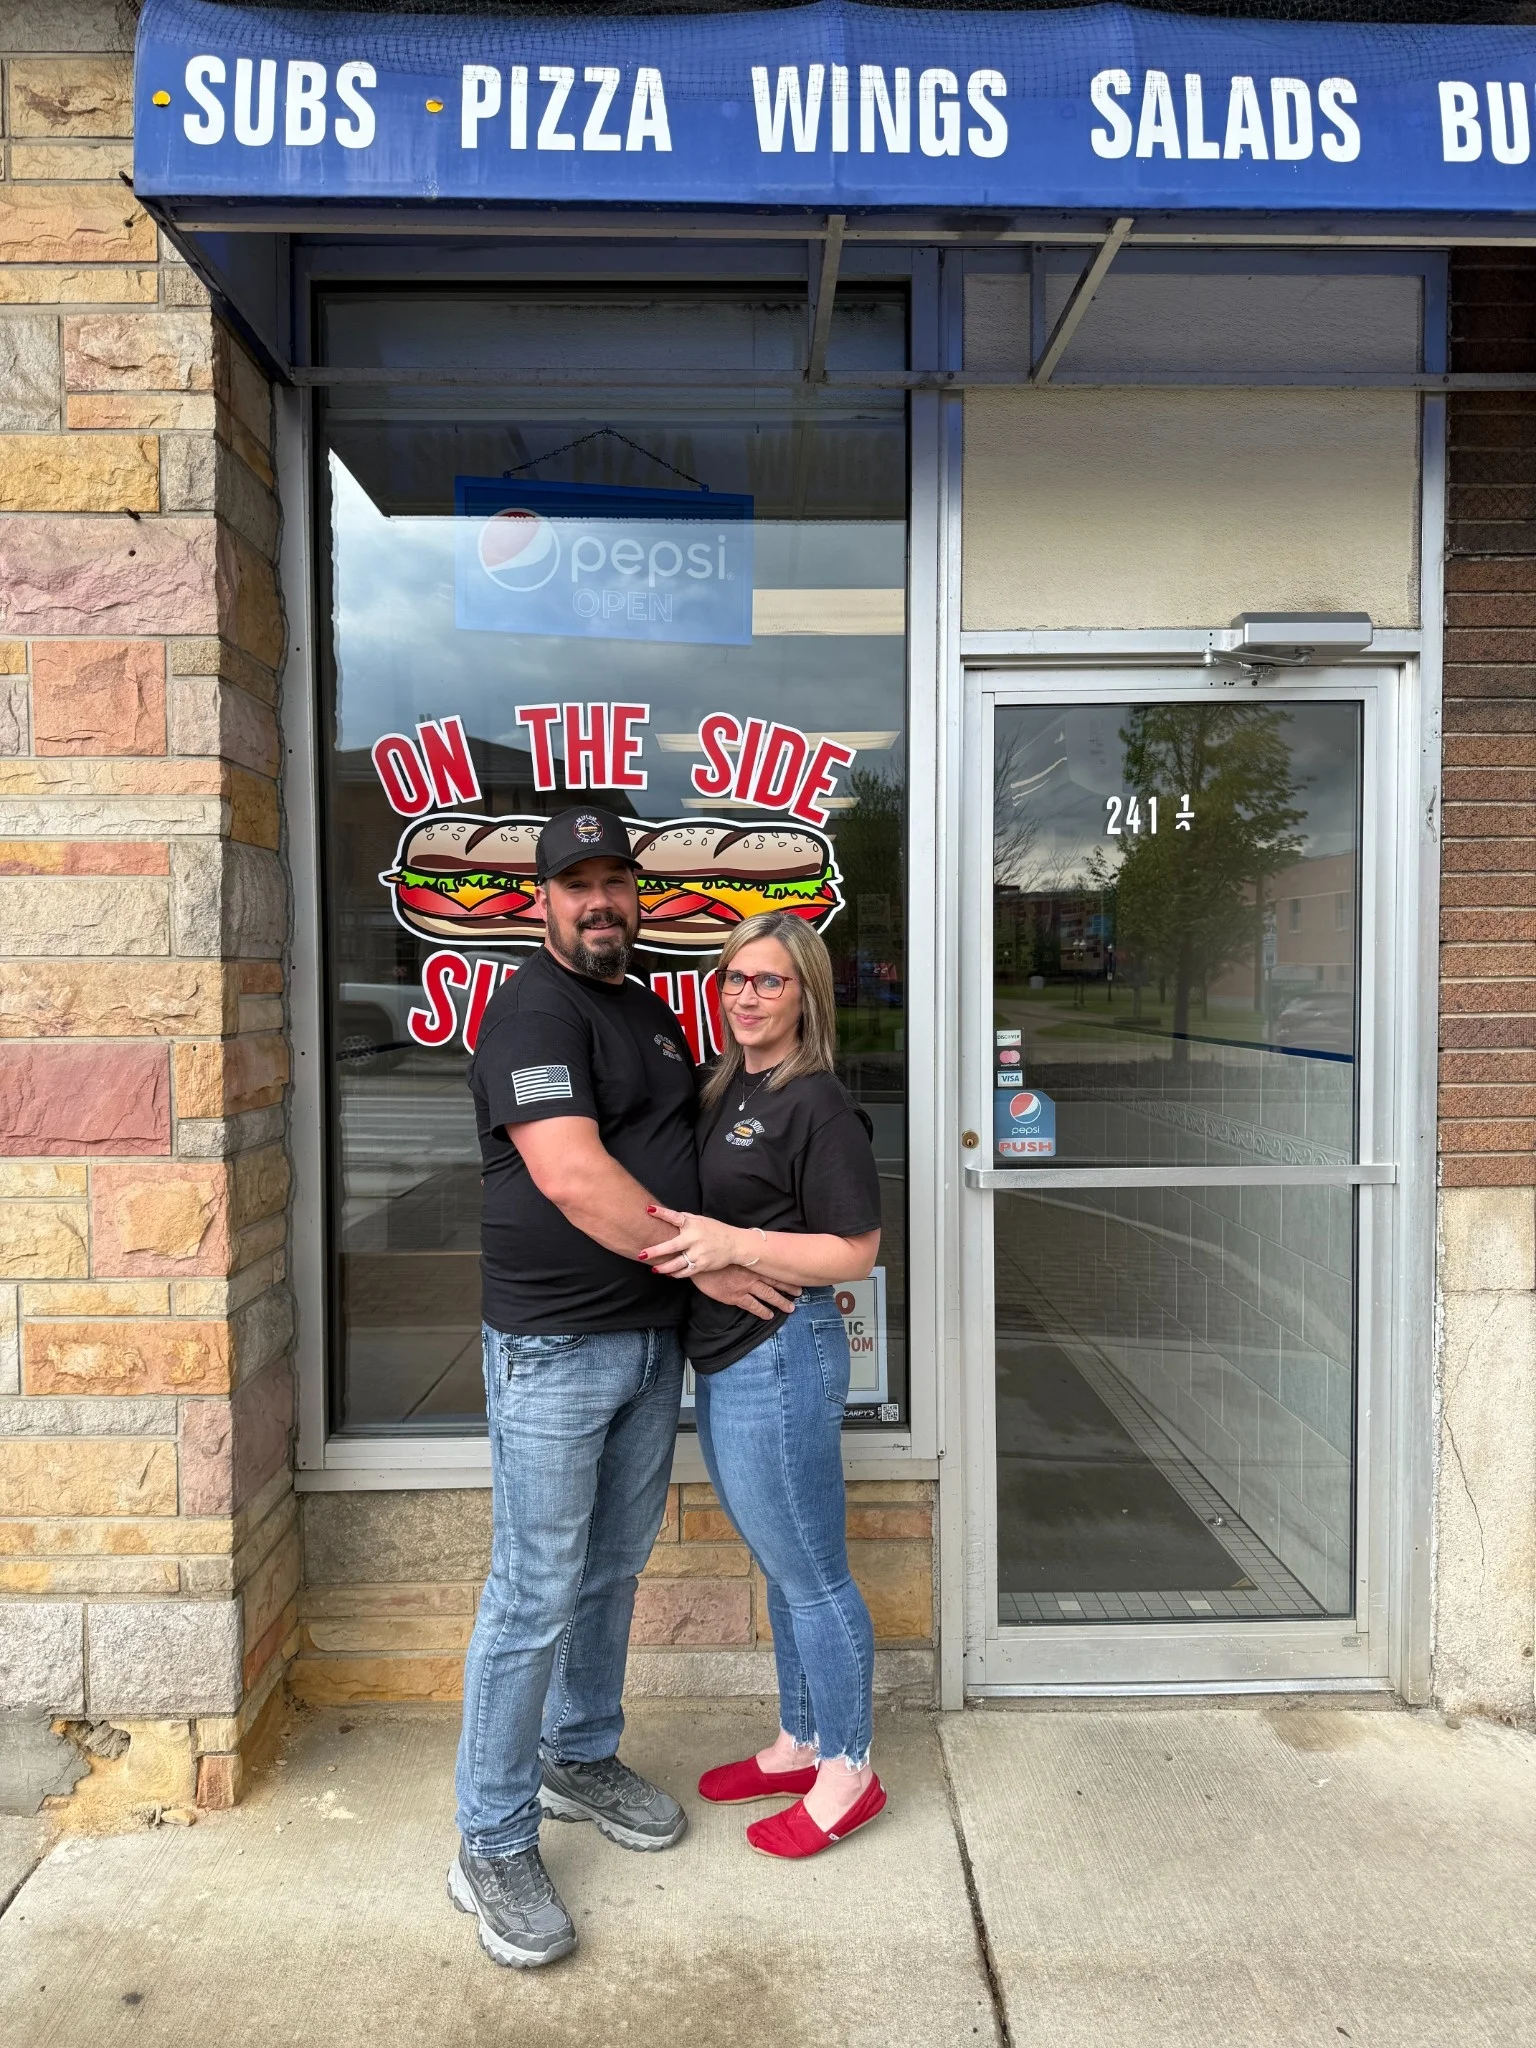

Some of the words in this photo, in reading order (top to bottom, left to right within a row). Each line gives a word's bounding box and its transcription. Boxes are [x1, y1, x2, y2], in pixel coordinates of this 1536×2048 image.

[184, 55, 377, 150] SUBS
[461, 64, 673, 152] PIZZA
[751, 63, 1008, 158] WINGS
[1090, 69, 1361, 163] SALADS
[1438, 81, 1536, 165] BU
[571, 535, 728, 587] pepsi
[572, 588, 673, 622] OPEN
[371, 715, 482, 817] ON
[514, 702, 650, 791] THE
[691, 712, 857, 829] SIDE
[1106, 796, 1157, 834] 241
[998, 1141, 1053, 1152] PUSH
[1012, 1125, 1040, 1135] pepsi
